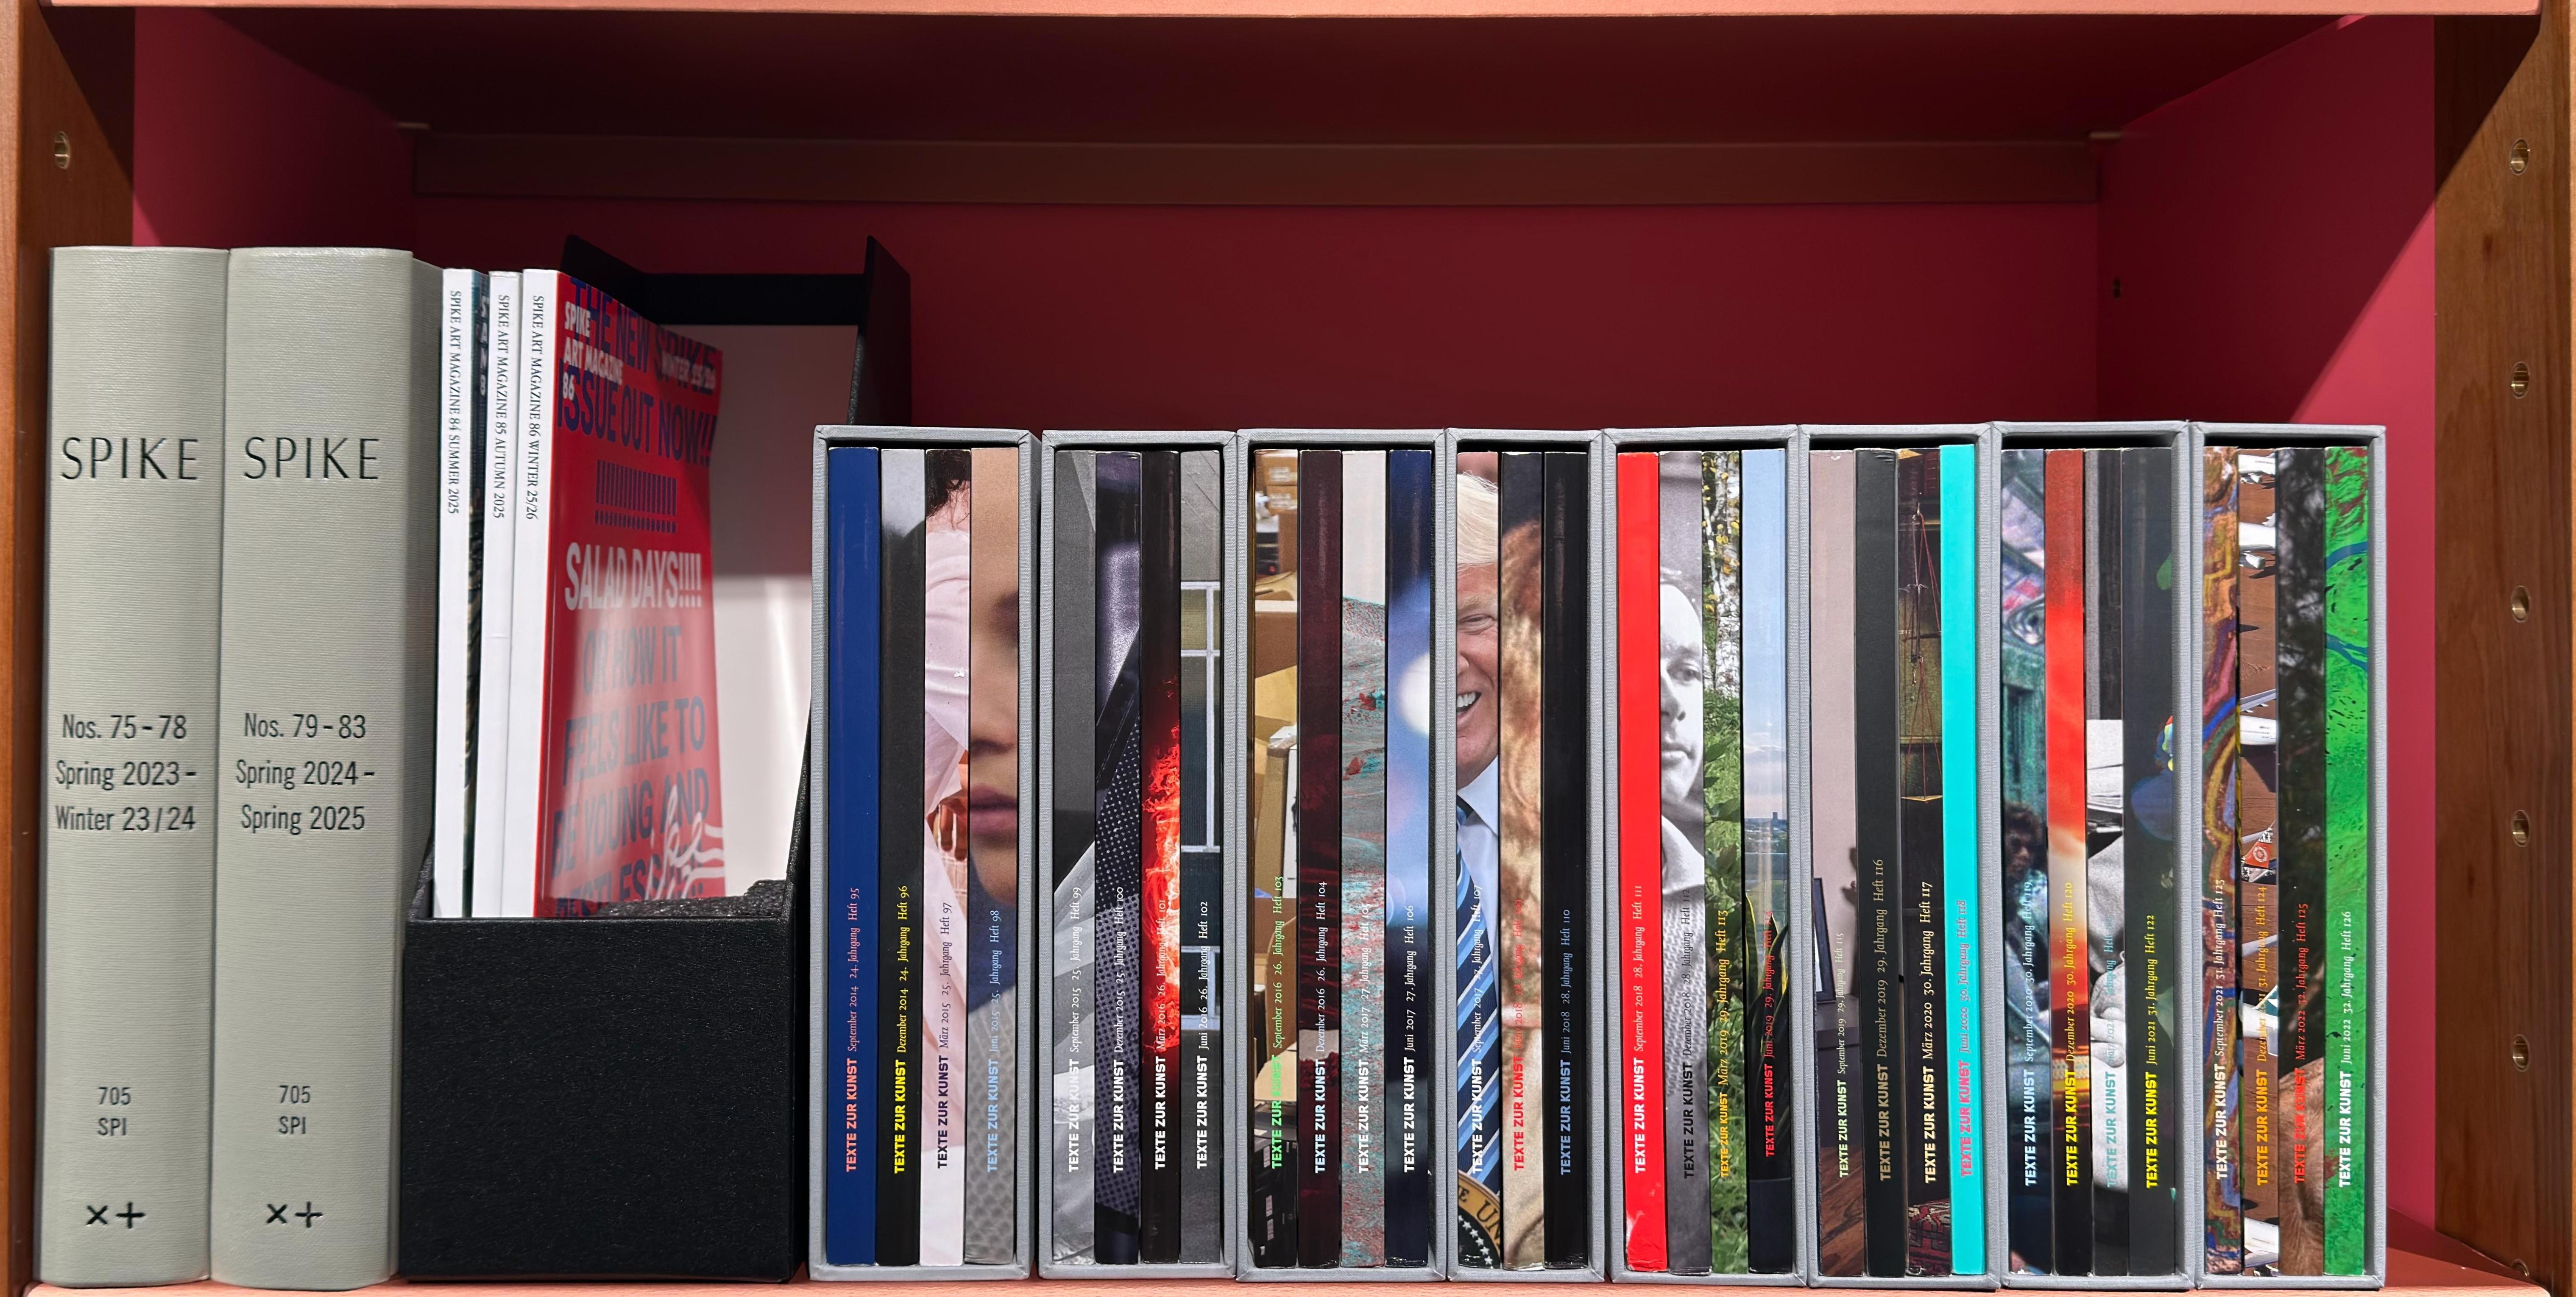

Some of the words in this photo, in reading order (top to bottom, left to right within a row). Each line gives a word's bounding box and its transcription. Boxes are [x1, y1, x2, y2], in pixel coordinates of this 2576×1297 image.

[450, 291, 461, 323] SPIKE
[498, 295, 509, 327] SPIKE
[532, 295, 544, 328] SPIKE
[564, 301, 591, 338] SPIKE
[450, 328, 460, 349] ART
[570, 277, 613, 353] THE
[616, 301, 652, 373] NEW
[498, 331, 508, 353] ART
[532, 331, 543, 354] ART
[563, 337, 583, 369] ART
[585, 344, 624, 386] MAGAZINE
[449, 353, 460, 414] MAGAZINE
[496, 356, 508, 418] MAGAZINE
[530, 358, 542, 419] MAGAZINE
[562, 372, 575, 401] 86
[557, 358, 618, 443] ISSUE
[621, 384, 654, 454] OUT
[449, 417, 460, 430] 84
[496, 422, 506, 434] 85
[529, 423, 541, 437] 86
[61, 437, 199, 479] SPIKE
[244, 437, 379, 479] SPIKE
[449, 435, 460, 484] SUMMER
[494, 438, 506, 489] AUTUMN
[527, 440, 539, 486] WINTER
[448, 489, 459, 514] 2025
[493, 493, 505, 518] 2025
[526, 490, 538, 519] 25/26
[565, 542, 627, 611] SALAD
[662, 625, 681, 683] IT
[62, 714, 102, 739] Nos.
[244, 713, 284, 738] Nos.
[624, 700, 669, 766] LIKE
[674, 696, 706, 753] TO
[56, 760, 114, 790] Spring
[236, 759, 296, 790] Spring
[55, 805, 114, 831] Winter
[241, 805, 301, 835] Spring
[309, 806, 365, 831] 2025
[584, 779, 653, 863] YOUNG
[659, 768, 710, 834] AND
[1873, 859, 1883, 876] 116
[850, 888, 859, 899] 95
[898, 885, 909, 898] 96
[1319, 881, 1327, 897] 104
[1872, 879, 1884, 902] Heft
[1922, 881, 1933, 897] 117
[847, 903, 857, 920] Heft
[897, 902, 907, 920] Heft
[1315, 902, 1325, 920] Heft
[1631, 902, 1642, 919] Heft
[1918, 901, 1930, 923] Heft
[2147, 915, 2155, 930] 122
[2341, 911, 2351, 927] 126
[1197, 921, 1207, 939] Heft
[1560, 928, 1570, 946] Heft
[1873, 909, 1888, 955] Jahrgang
[2144, 933, 2155, 953] Heft
[2340, 930, 2351, 950] Heft
[848, 928, 860, 963] Jahrgang
[897, 927, 910, 962] Jahrgang
[1315, 927, 1328, 962] Jahrgang
[1632, 926, 1645, 962] Jahrgang
[1920, 931, 1935, 976] Jahrgang
[850, 964, 859, 978] 24.
[899, 967, 909, 981] 24.
[1198, 946, 1210, 980] Jahrgang
[1316, 967, 1325, 981] 26.
[1560, 953, 1573, 988] Jahrgang
[1633, 964, 1642, 978] 28.
[1877, 957, 1888, 973] 29.
[1924, 979, 1934, 995] 30.
[2144, 959, 2158, 1001] Jahrgang
[2341, 956, 2353, 998] Jahrgang
[849, 985, 859, 1007] 2014
[899, 988, 909, 1010] 2014
[1198, 985, 1208, 999] 26.
[1316, 988, 1325, 1010] 2016
[1561, 990, 1570, 1004] 28.
[1633, 985, 1643, 1007] 2018
[1878, 980, 1888, 1004] 2019
[1198, 1006, 1208, 1028] 2016
[1924, 1002, 1932, 1028] 2020
[2148, 1003, 2158, 1016] 31.
[2343, 1000, 2353, 1014] 32.
[847, 1010, 860, 1052] September
[896, 1014, 906, 1053] Dezember
[1315, 1013, 1325, 1052] Dezember
[1561, 1011, 1570, 1033] 2018
[1633, 1010, 1647, 1052] September
[1875, 1007, 1887, 1058] Dezember
[2342, 1019, 2351, 1041] 2022
[1199, 1033, 1209, 1050] Juni
[1561, 1037, 1572, 1054] Juni
[1921, 1032, 1933, 1059] März
[2340, 1045, 2352, 1064] Juni
[2145, 1046, 2158, 1065] Juni
[847, 1058, 857, 1100] KUNST
[895, 1059, 906, 1102] KUNST
[1197, 1055, 1207, 1097] KUNST
[1315, 1059, 1325, 1101] KUNST
[1560, 1059, 1570, 1102] KUNST
[1633, 1057, 1645, 1100] KUNST
[1877, 1064, 1889, 1107] KUNST
[1923, 1066, 1935, 1109] KUNST
[98, 1086, 132, 1106] 705
[279, 1085, 312, 1104] 705
[2145, 1072, 2157, 1115] KUNST
[2339, 1071, 2351, 1114] KUNST
[98, 1118, 128, 1136] SPI
[278, 1116, 307, 1135] SPI
[846, 1104, 857, 1129] ZUR
[895, 1105, 906, 1131] ZUR
[1197, 1100, 1207, 1127] ZUR
[1315, 1104, 1325, 1130] ZUR
[1560, 1105, 1571, 1132] ZUR
[1634, 1104, 1645, 1130] ZUR
[1878, 1111, 1890, 1137] ZUR
[1924, 1113, 1935, 1139] ZUR
[2146, 1118, 2157, 1145] ZUR
[2339, 1117, 2351, 1144] ZUR
[846, 1133, 857, 1172] TEXTE
[894, 1134, 905, 1174] TEXTE
[1197, 1130, 1207, 1169] TEXTE
[1315, 1134, 1325, 1174] TEXTE
[1560, 1136, 1571, 1175] TEXTE
[1634, 1133, 1646, 1174] TEXTE
[1879, 1141, 1891, 1181] TEXTE
[1924, 1143, 1936, 1183] TEXTE
[2146, 1148, 2158, 1188] TEXTE
[2339, 1147, 2351, 1188] TEXTE
